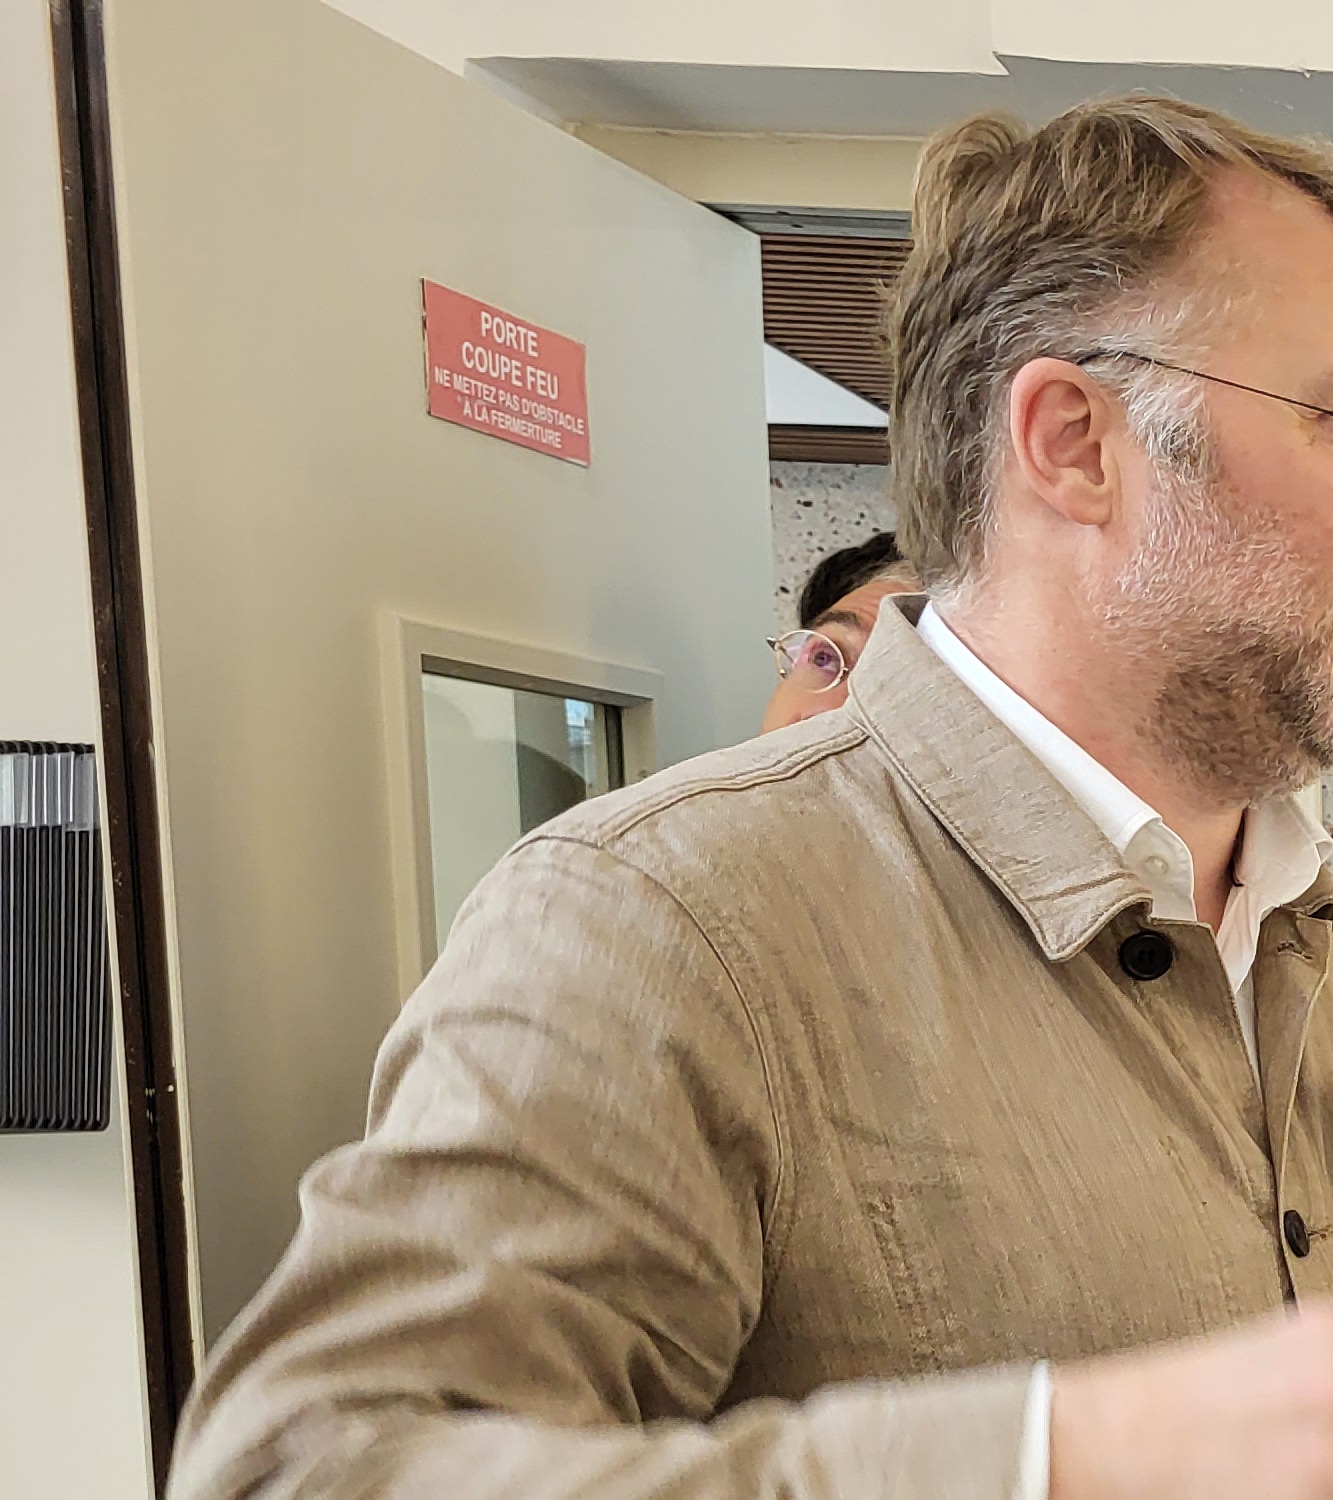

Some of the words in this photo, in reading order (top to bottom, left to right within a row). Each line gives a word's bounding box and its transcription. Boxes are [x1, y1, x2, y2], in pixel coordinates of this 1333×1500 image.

[480, 310, 539, 358] PORTE
[461, 340, 523, 387] COUPE
[526, 364, 559, 400] FEU
[434, 365, 451, 388] NE
[453, 372, 497, 404] METTEZ
[499, 388, 520, 412] PAS
[521, 396, 585, 435] D'OBSTACLE
[474, 404, 490, 424] LA
[491, 408, 563, 448] FERMERTURE
